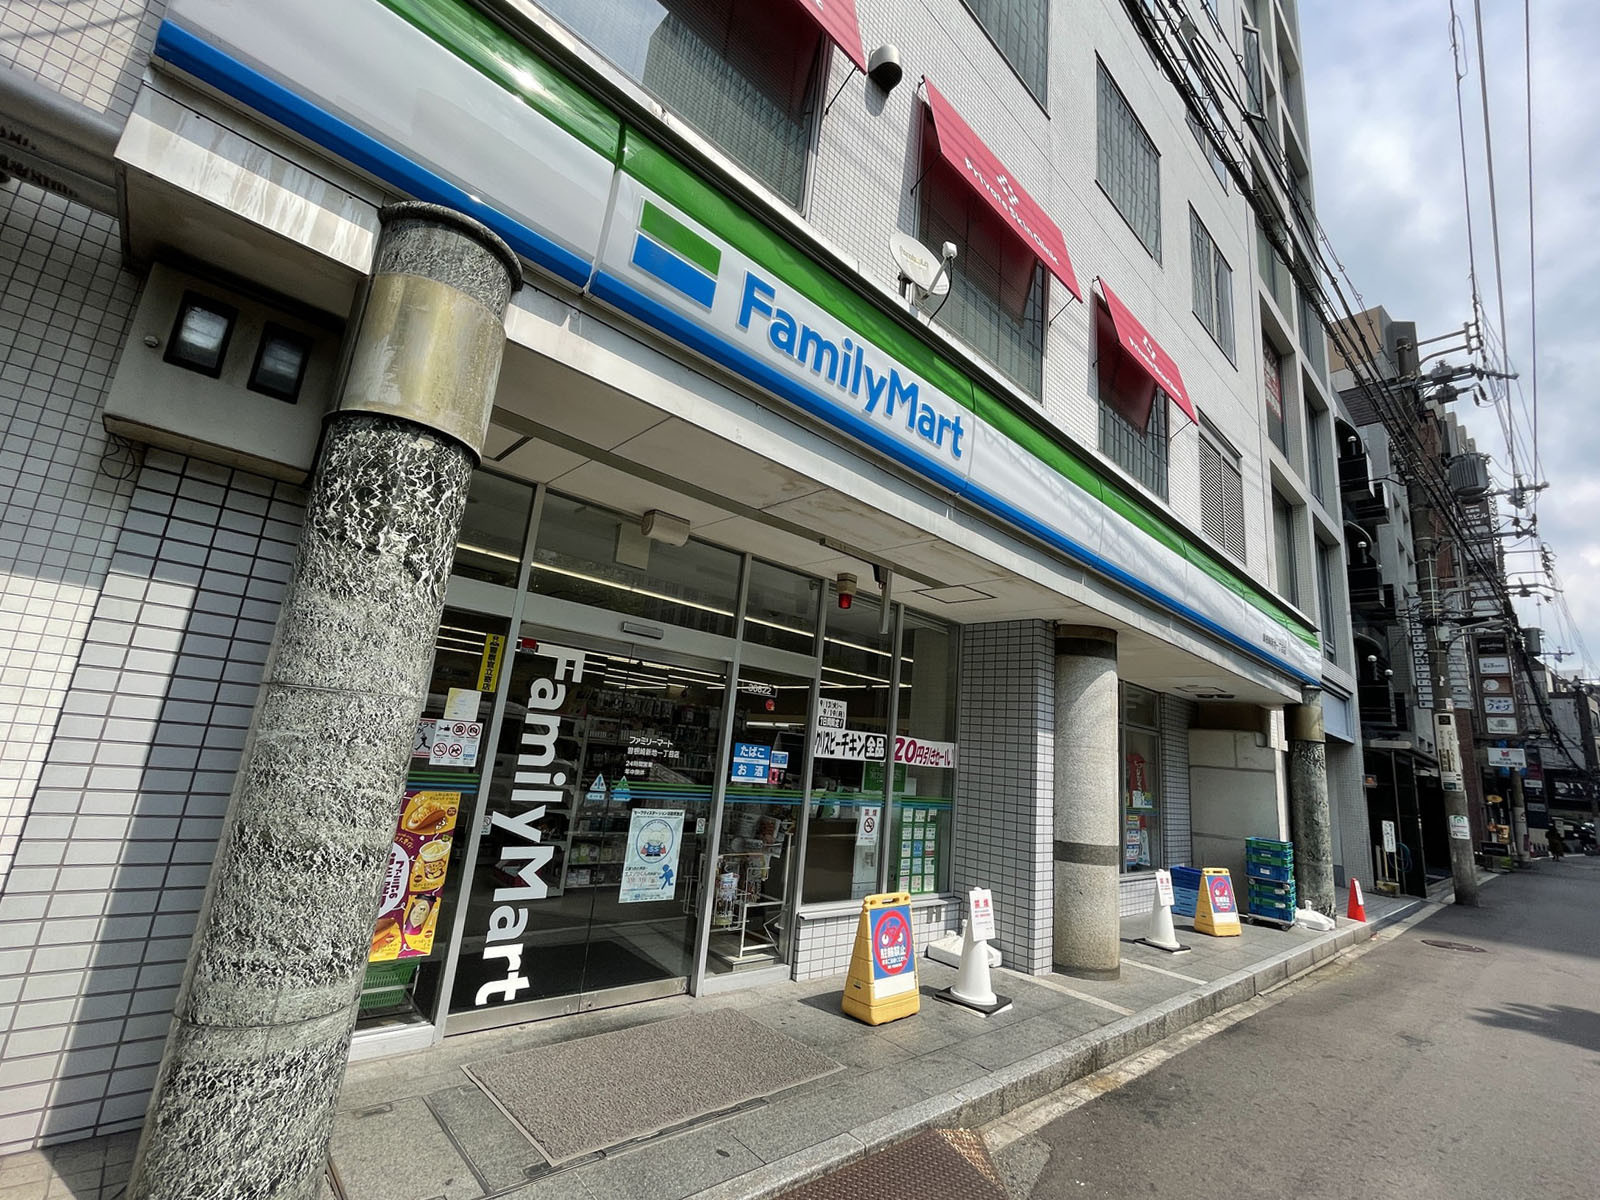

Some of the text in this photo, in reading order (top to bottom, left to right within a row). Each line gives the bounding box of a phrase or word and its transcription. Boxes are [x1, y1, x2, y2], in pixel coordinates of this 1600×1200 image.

[736, 270, 965, 459] FamilyMart
[629, 736, 674, 748] ファミリーマート
[740, 745, 765, 758] たばこ
[474, 643, 586, 1007] FamilyMart
